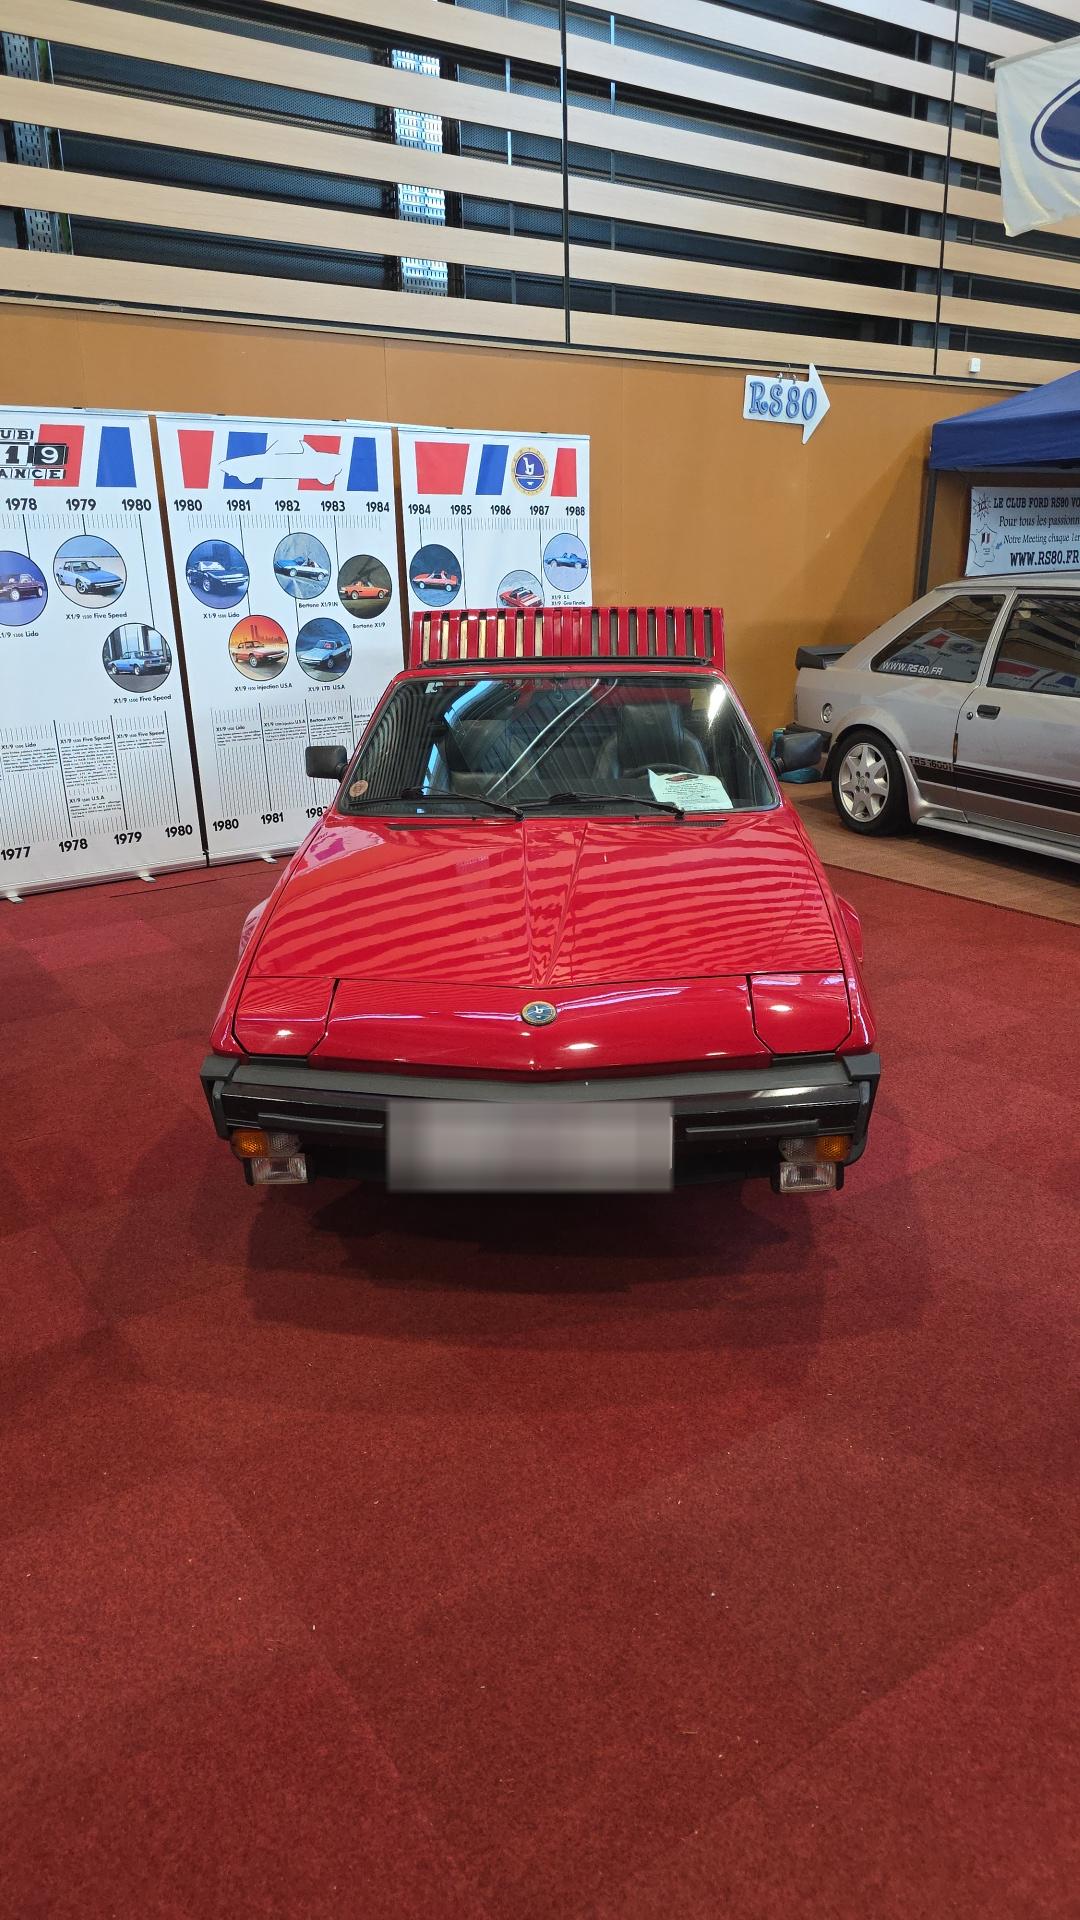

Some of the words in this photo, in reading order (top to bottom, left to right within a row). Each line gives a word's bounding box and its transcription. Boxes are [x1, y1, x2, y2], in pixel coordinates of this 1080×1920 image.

[749, 381, 817, 421] RS80
[6, 498, 37, 511] 1978
[66, 499, 96, 511] 1979
[122, 499, 151, 511] 1980
[174, 500, 203, 512] 1980
[227, 500, 250, 512] 1981
[275, 500, 300, 512] 1982
[320, 501, 345, 512] 1983
[366, 502, 390, 513] 1984
[994, 498, 1003, 508] LE
[1006, 498, 1027, 508] CLUB
[1029, 498, 1049, 508] FORD
[408, 504, 431, 515] 1984
[450, 505, 472, 515] 1985
[491, 505, 511, 515] 1986
[530, 506, 549, 516] 1987
[565, 506, 585, 516] 1988
[999, 515, 1017, 527] Pour
[1020, 516, 1035, 526] tous
[1036, 515, 1046, 526] les
[1004, 535, 1020, 544] Notre
[1022, 534, 1046, 546] Meeting
[1049, 533, 1070, 545] chaque
[1010, 550, 1079, 567] WWW.RS80.FR
[882, 662, 943, 675] WWW.RS80.FR
[153, 694, 171, 702] Speed
[212, 819, 239, 831] 1980
[261, 812, 284, 824] 1981
[306, 806, 328, 818] 198
[1, 846, 31, 860] 1977
[59, 838, 88, 852] 1978
[114, 832, 143, 845] 1979
[165, 824, 193, 838] 1980
